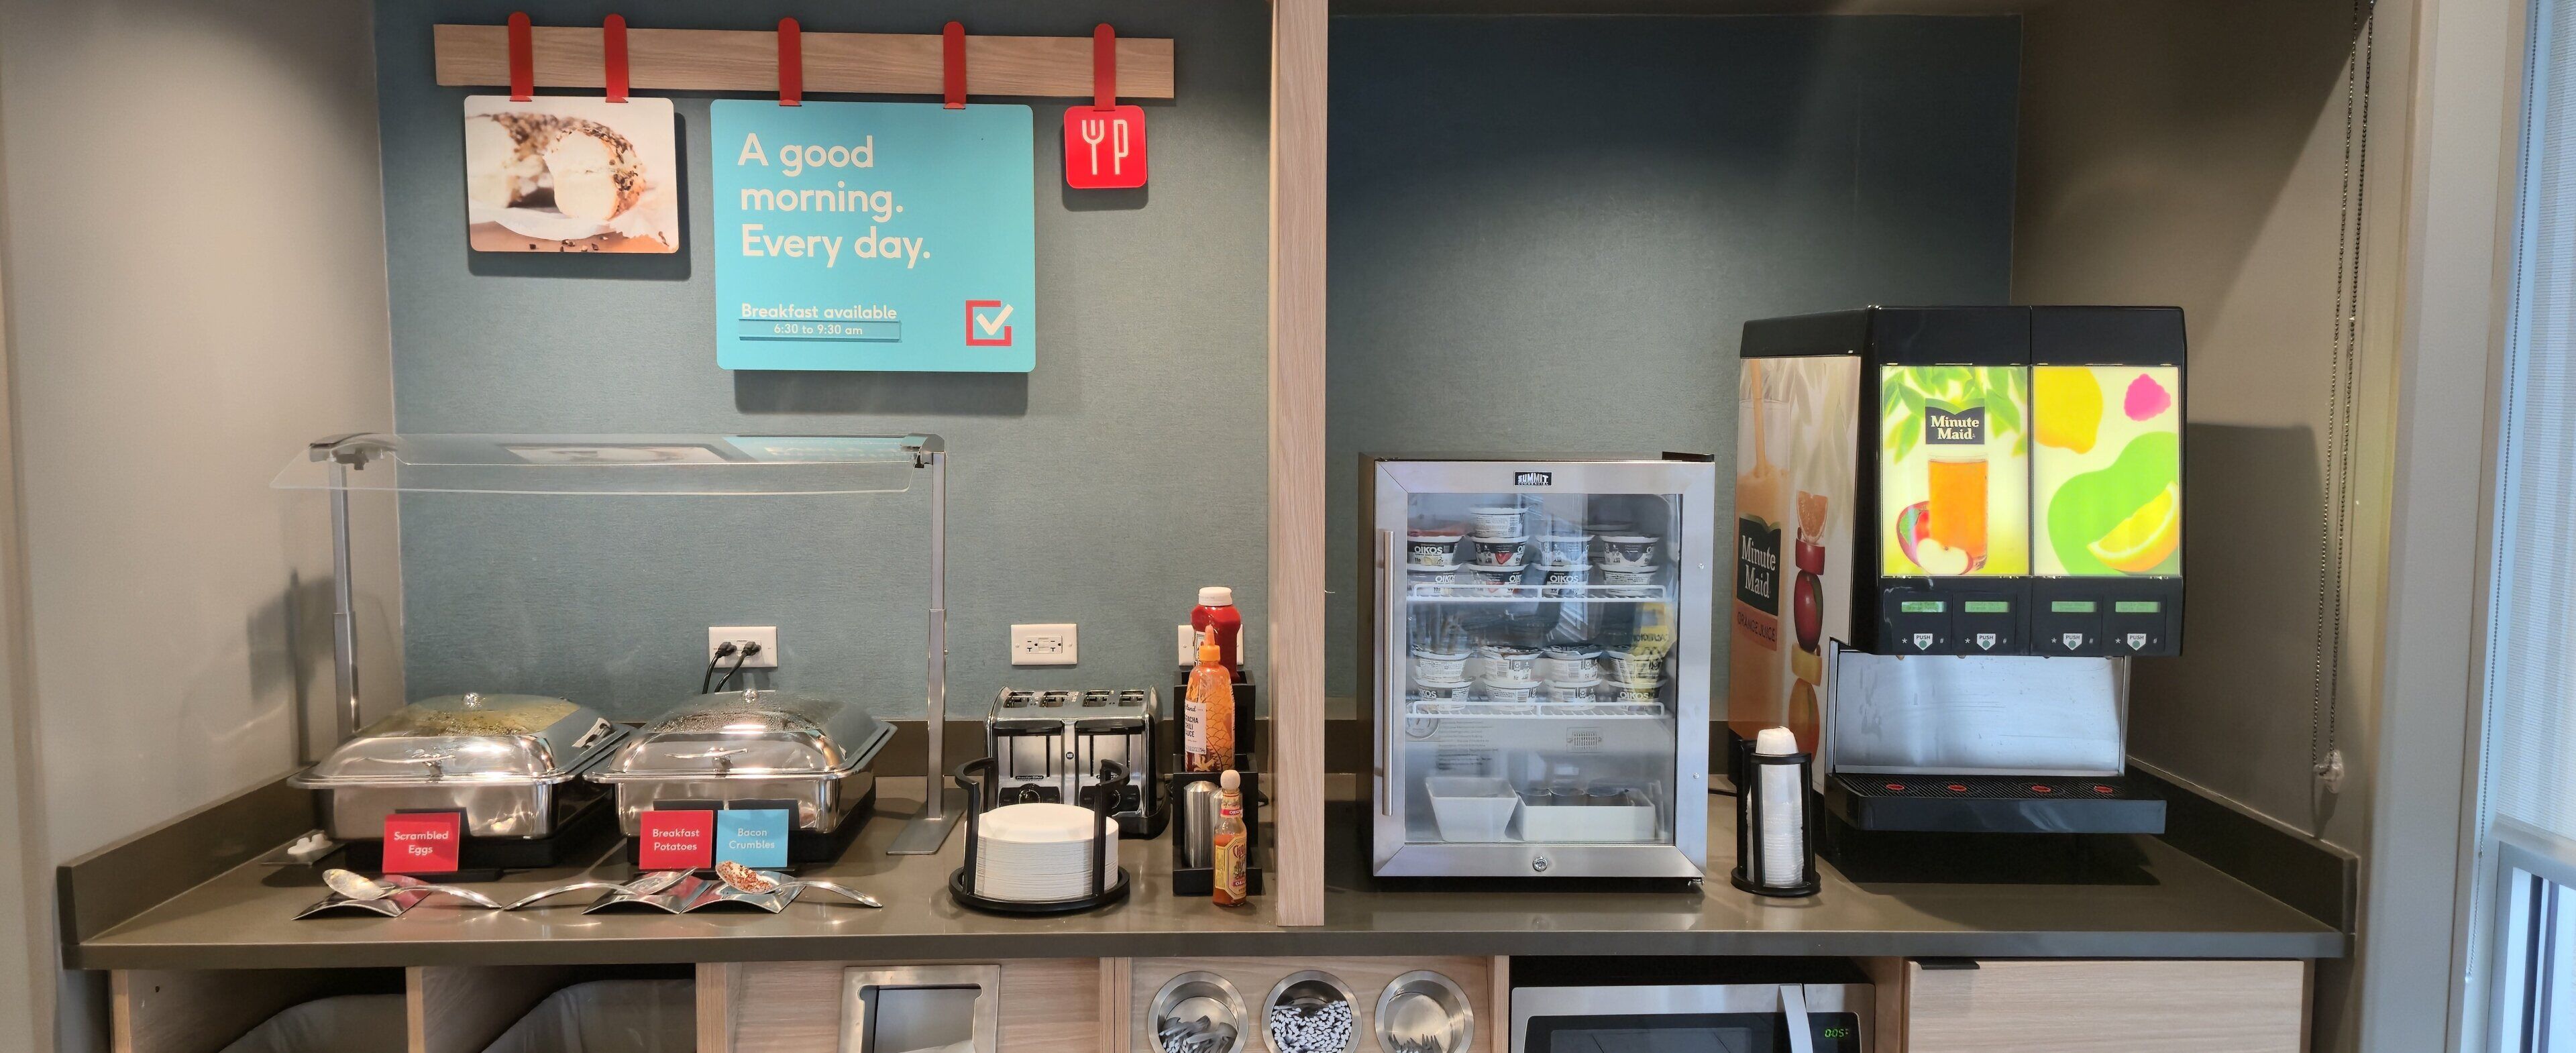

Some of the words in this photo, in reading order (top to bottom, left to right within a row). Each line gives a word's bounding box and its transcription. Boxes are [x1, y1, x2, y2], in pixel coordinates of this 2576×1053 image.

[737, 132, 769, 166] A
[780, 135, 874, 177] good
[741, 180, 904, 223] morning.
[742, 223, 843, 268] Every
[854, 225, 930, 269] day.
[741, 302, 818, 319] Breakfast
[824, 304, 898, 319] available
[773, 323, 798, 334] 6:30
[802, 325, 814, 334] to
[817, 323, 842, 335] 9:30
[1931, 415, 1980, 427] Minute
[1937, 427, 1973, 440] Maid
[1517, 473, 1549, 482] SUMMIT
[1414, 546, 1443, 554] OIKOS
[1741, 535, 1776, 571] Minute
[1550, 575, 1578, 584] OIKOS
[1745, 564, 1770, 599] Maid
[1737, 611, 1758, 634] ORANGE
[1758, 624, 1776, 643] JUICE
[1619, 691, 1650, 700] OIKOS
[394, 830, 449, 841] Scrambled
[653, 828, 700, 838] Breakfast
[737, 828, 767, 837] Bacon
[409, 844, 433, 856] Eggs
[654, 842, 698, 851] Potatoes
[729, 840, 775, 849] Crumbles
